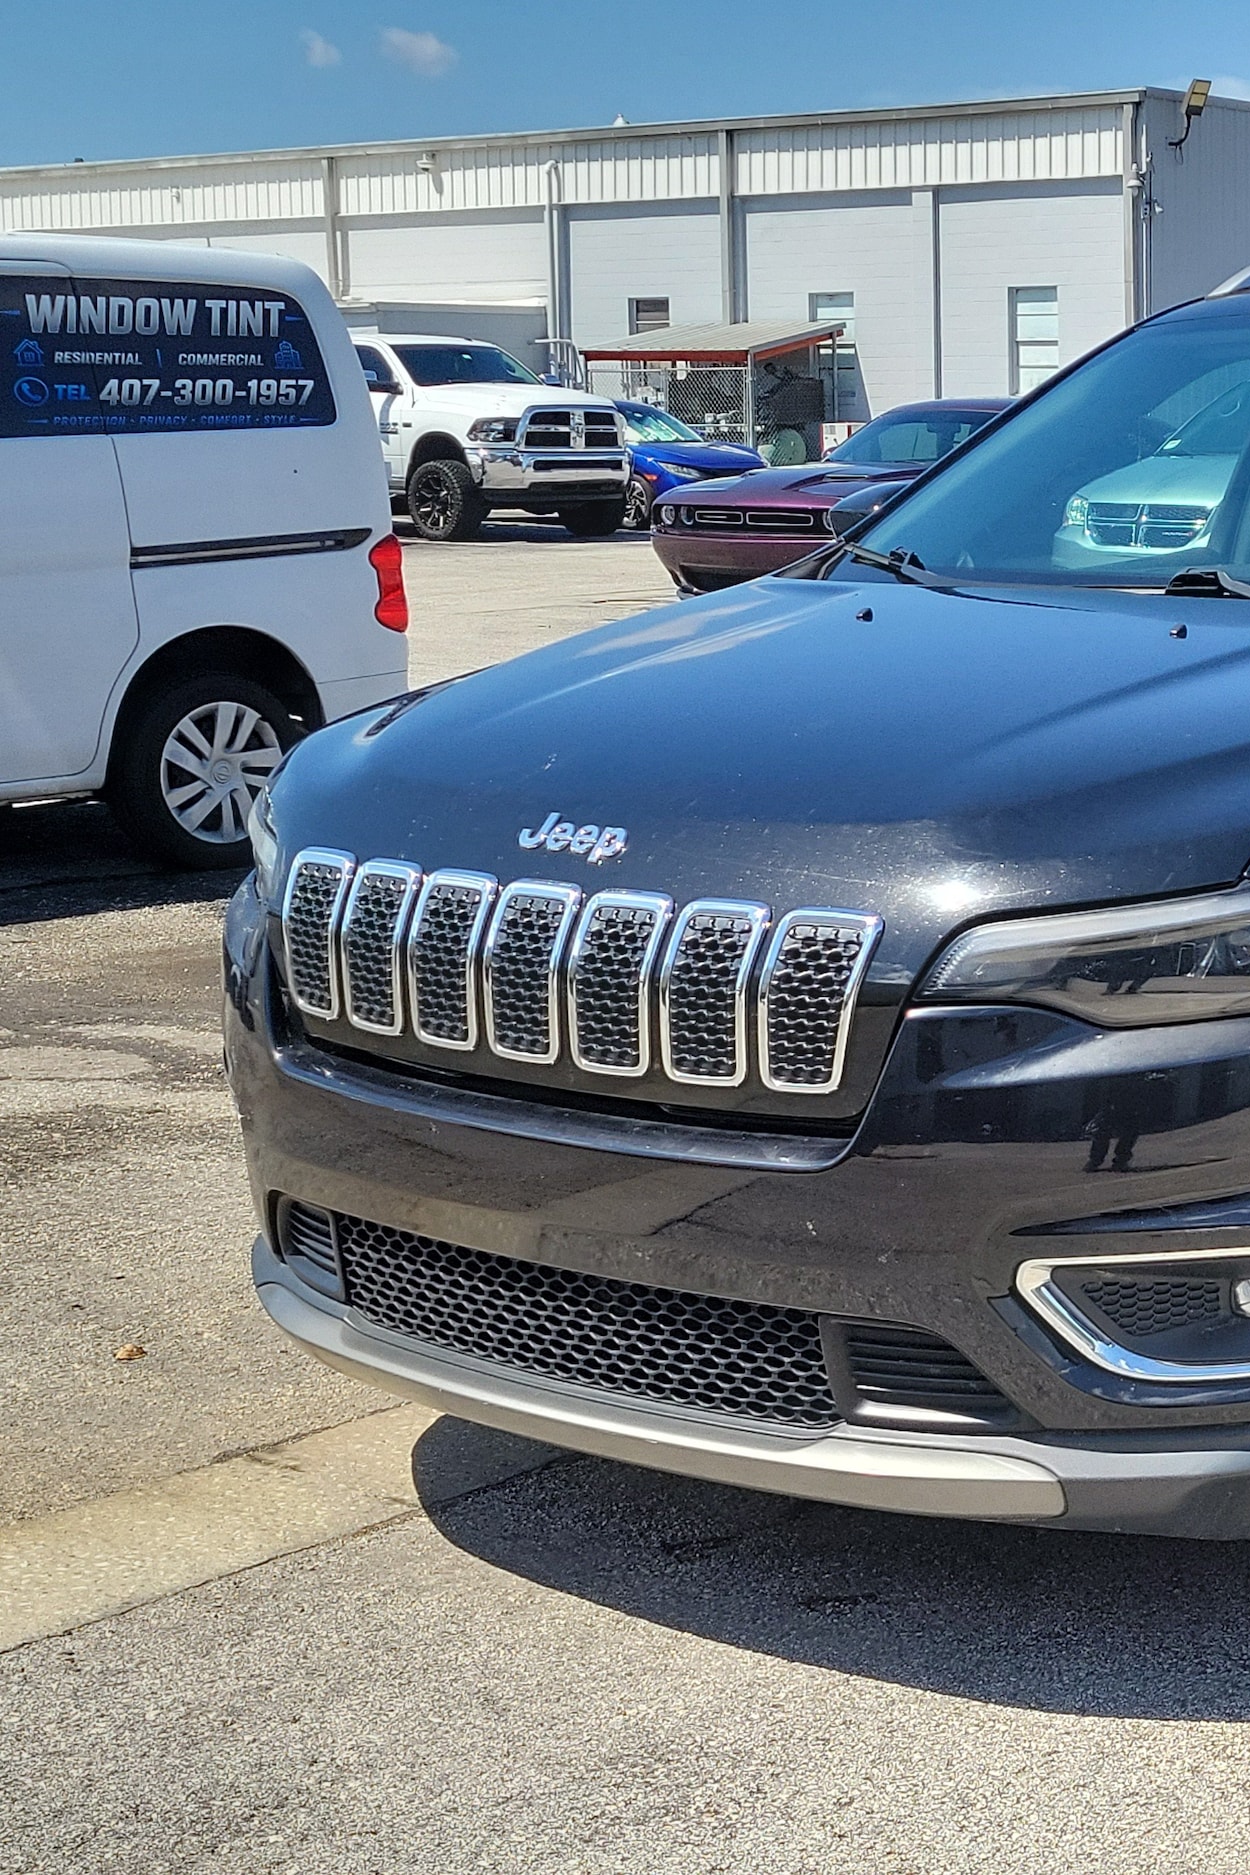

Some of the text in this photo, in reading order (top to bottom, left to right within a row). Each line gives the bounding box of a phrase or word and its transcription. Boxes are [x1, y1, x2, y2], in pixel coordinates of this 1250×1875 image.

[25, 294, 285, 337] WINDOW TINT
[54, 351, 265, 366] RESIDENTIAL COMMERCIAL
[54, 378, 315, 407] TEL 407-300-1957
[53, 414, 296, 426] PROTECTION PRIVACY COMFORT STYLE
[518, 811, 628, 865] Jeep
